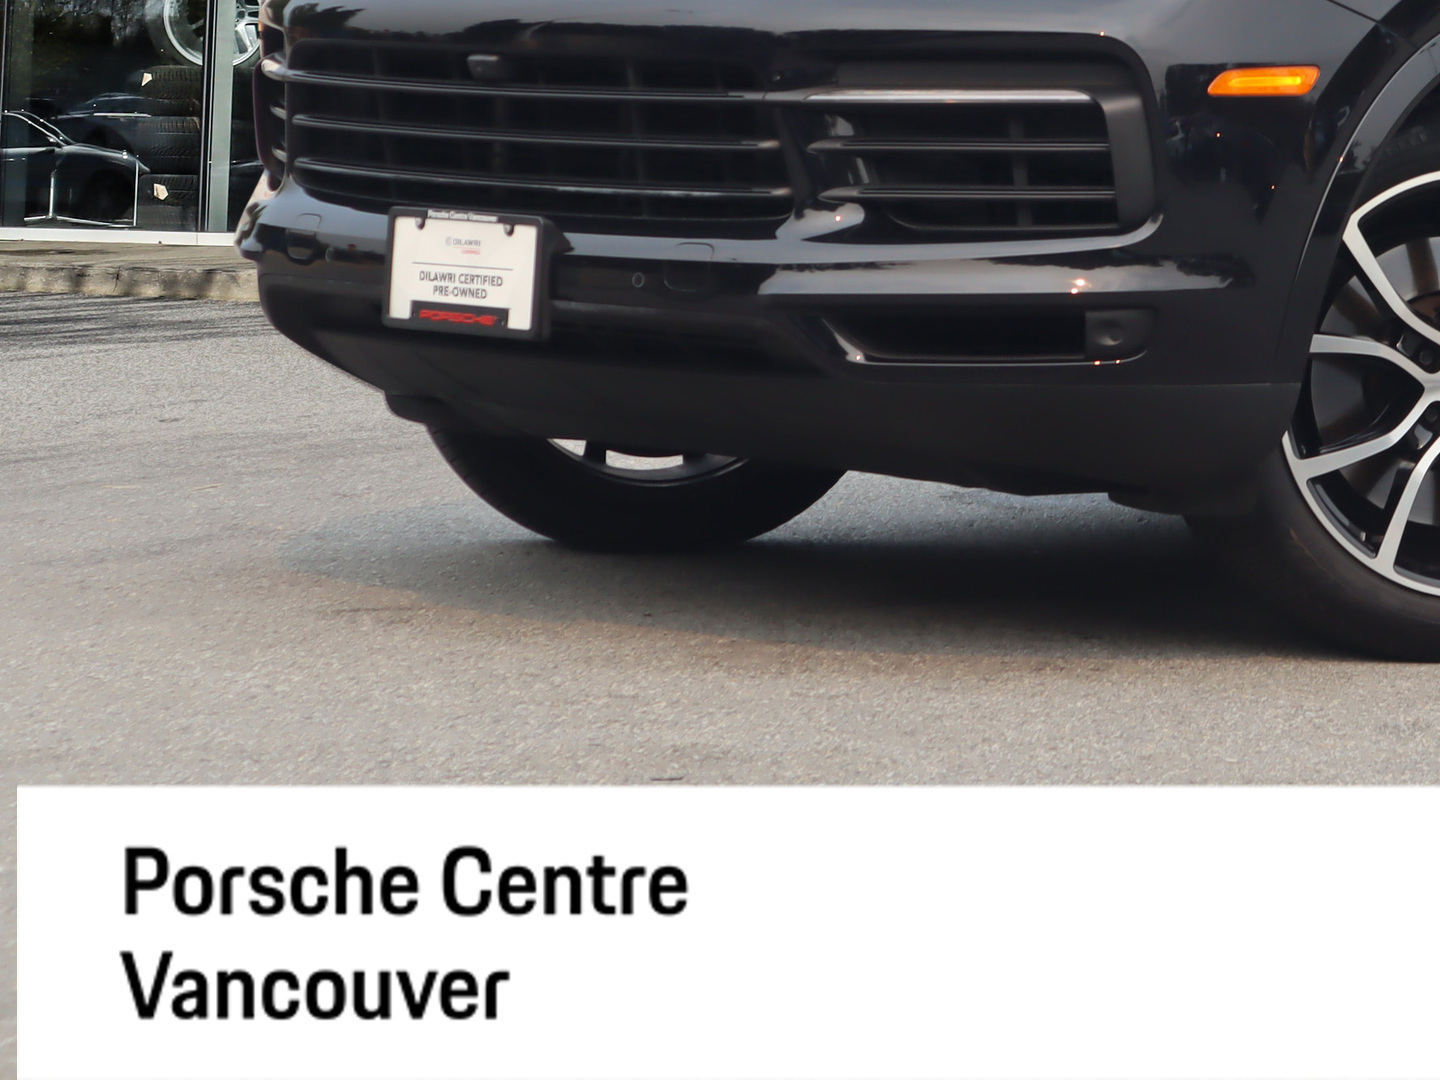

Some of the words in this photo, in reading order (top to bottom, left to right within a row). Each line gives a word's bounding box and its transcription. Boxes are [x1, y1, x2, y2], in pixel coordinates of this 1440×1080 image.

[419, 270, 456, 283] DILAWRI
[458, 273, 503, 287] CERTIFIED
[433, 285, 487, 299] PRE-OWNED
[419, 309, 498, 326] PORSCHE
